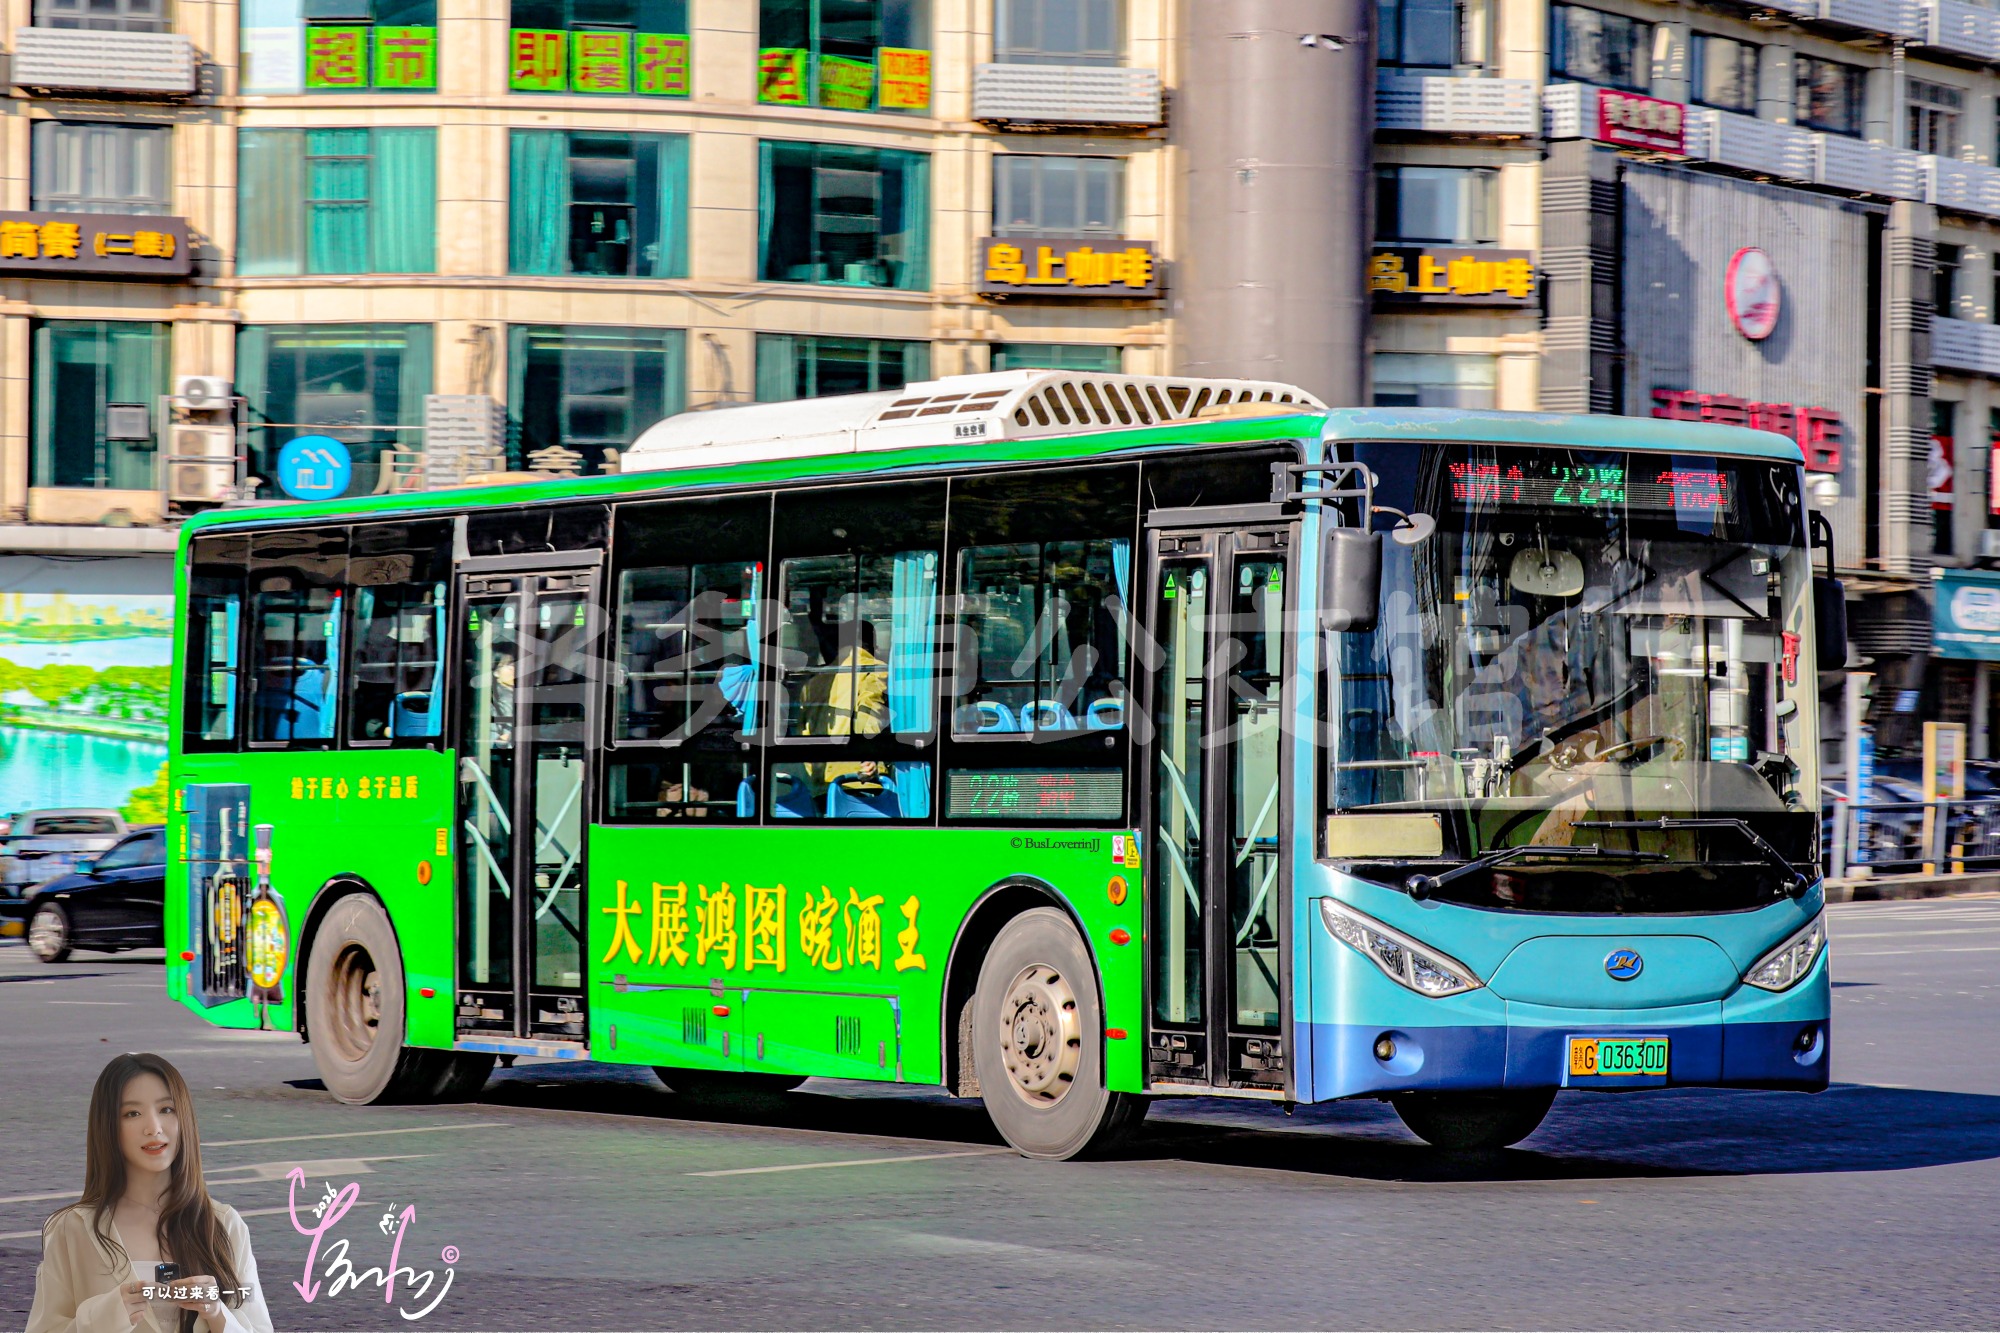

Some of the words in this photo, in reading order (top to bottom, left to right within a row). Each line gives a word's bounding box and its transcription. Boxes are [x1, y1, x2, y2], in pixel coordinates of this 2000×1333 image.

[311, 30, 428, 85] 超市
[602, 878, 788, 975] 大展鸿图
[798, 884, 928, 974] 皖酒王
